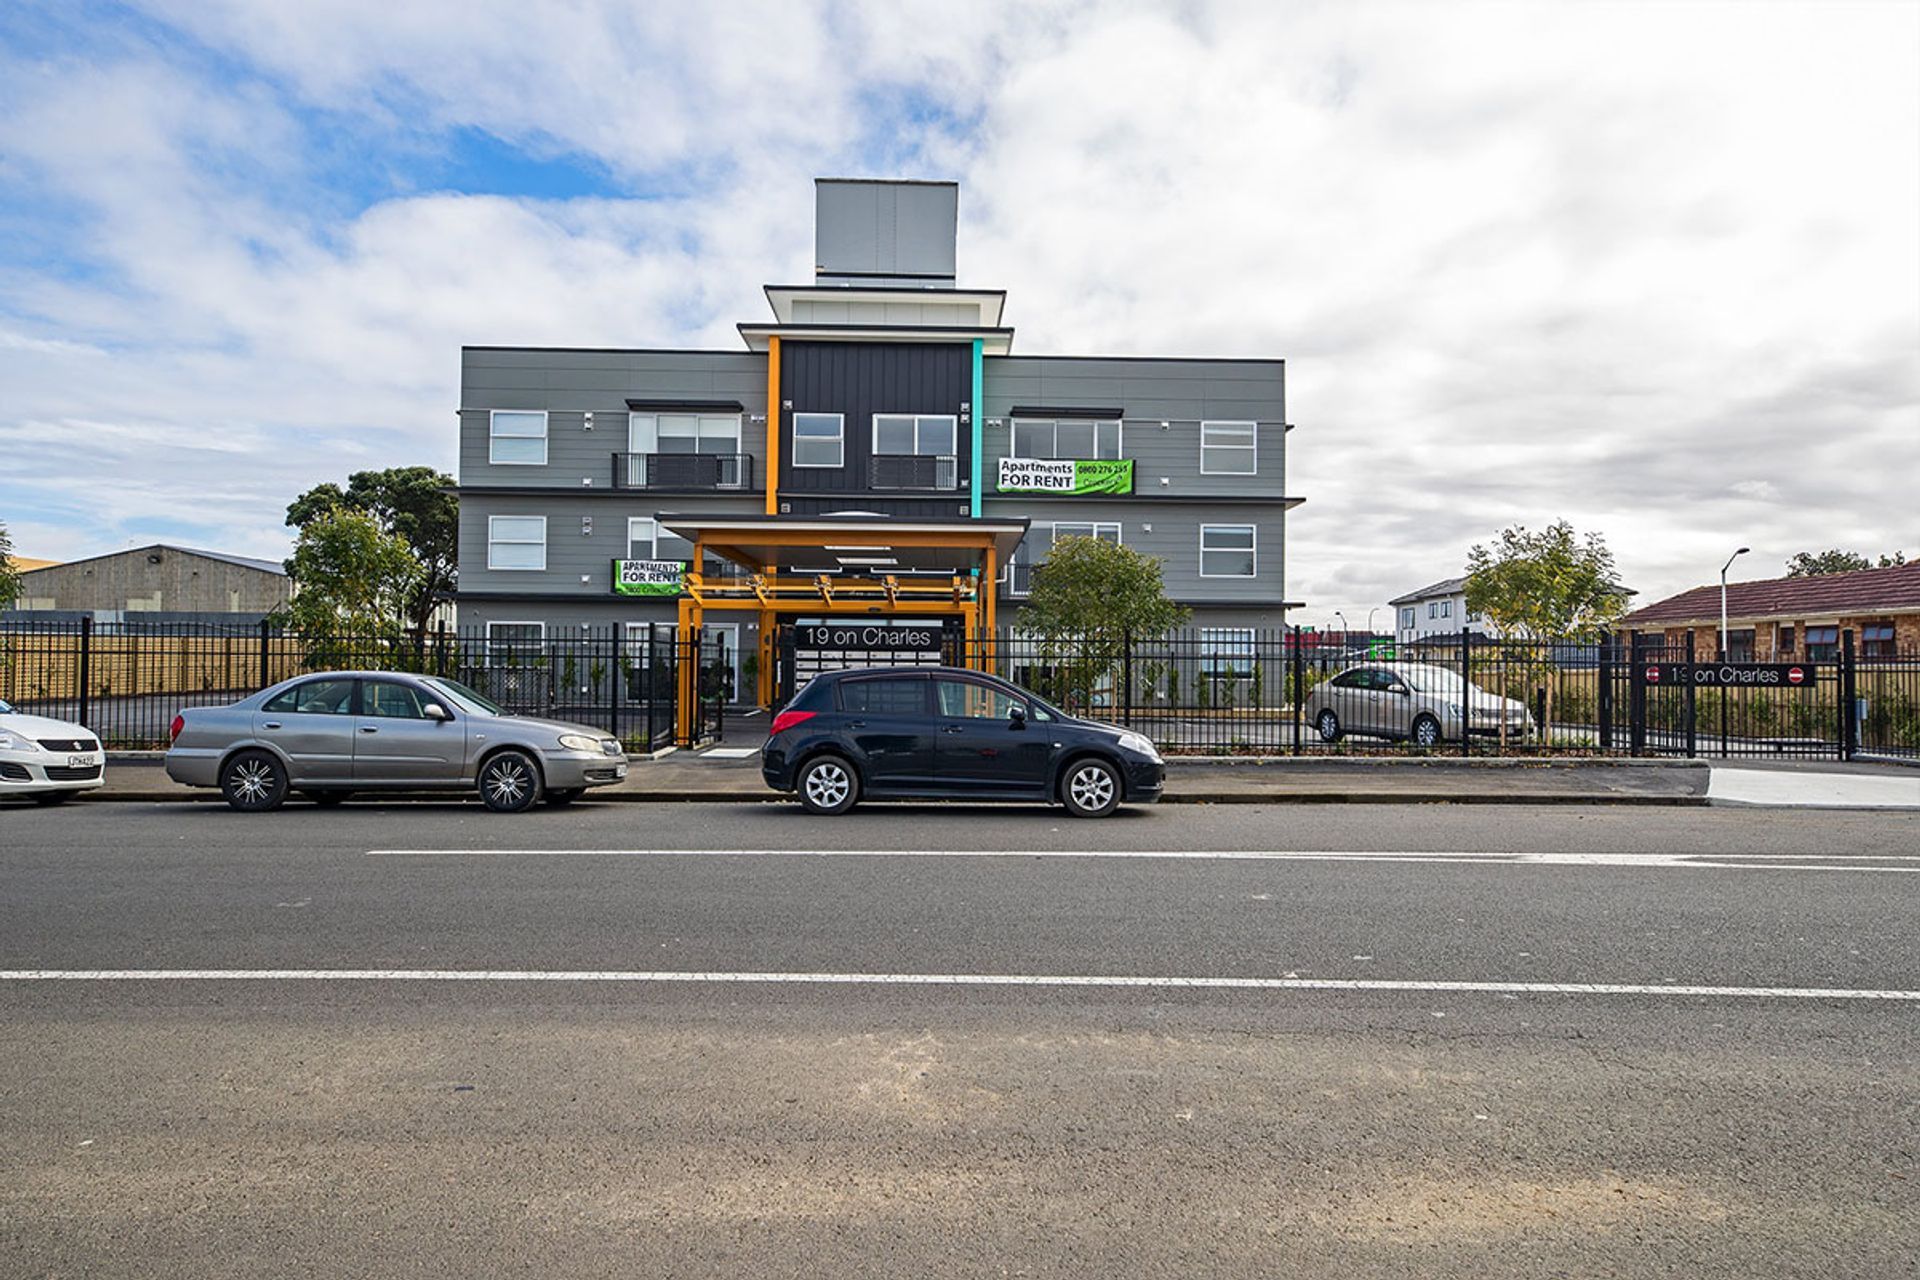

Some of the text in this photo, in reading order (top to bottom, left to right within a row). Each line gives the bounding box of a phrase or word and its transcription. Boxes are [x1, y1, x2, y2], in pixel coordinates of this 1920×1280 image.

[1001, 460, 1072, 473] Apartments
[1078, 465, 1097, 474] 0800
[1099, 465, 1112, 474] 276
[1001, 474, 1031, 486] FOR
[1033, 475, 1073, 488] RENT
[623, 562, 679, 572] APARTMENTS
[623, 572, 677, 582] FOR RENT
[806, 627, 931, 646] 19 on Charles
[1694, 670, 1715, 683] on
[1719, 666, 1779, 683] Charles
